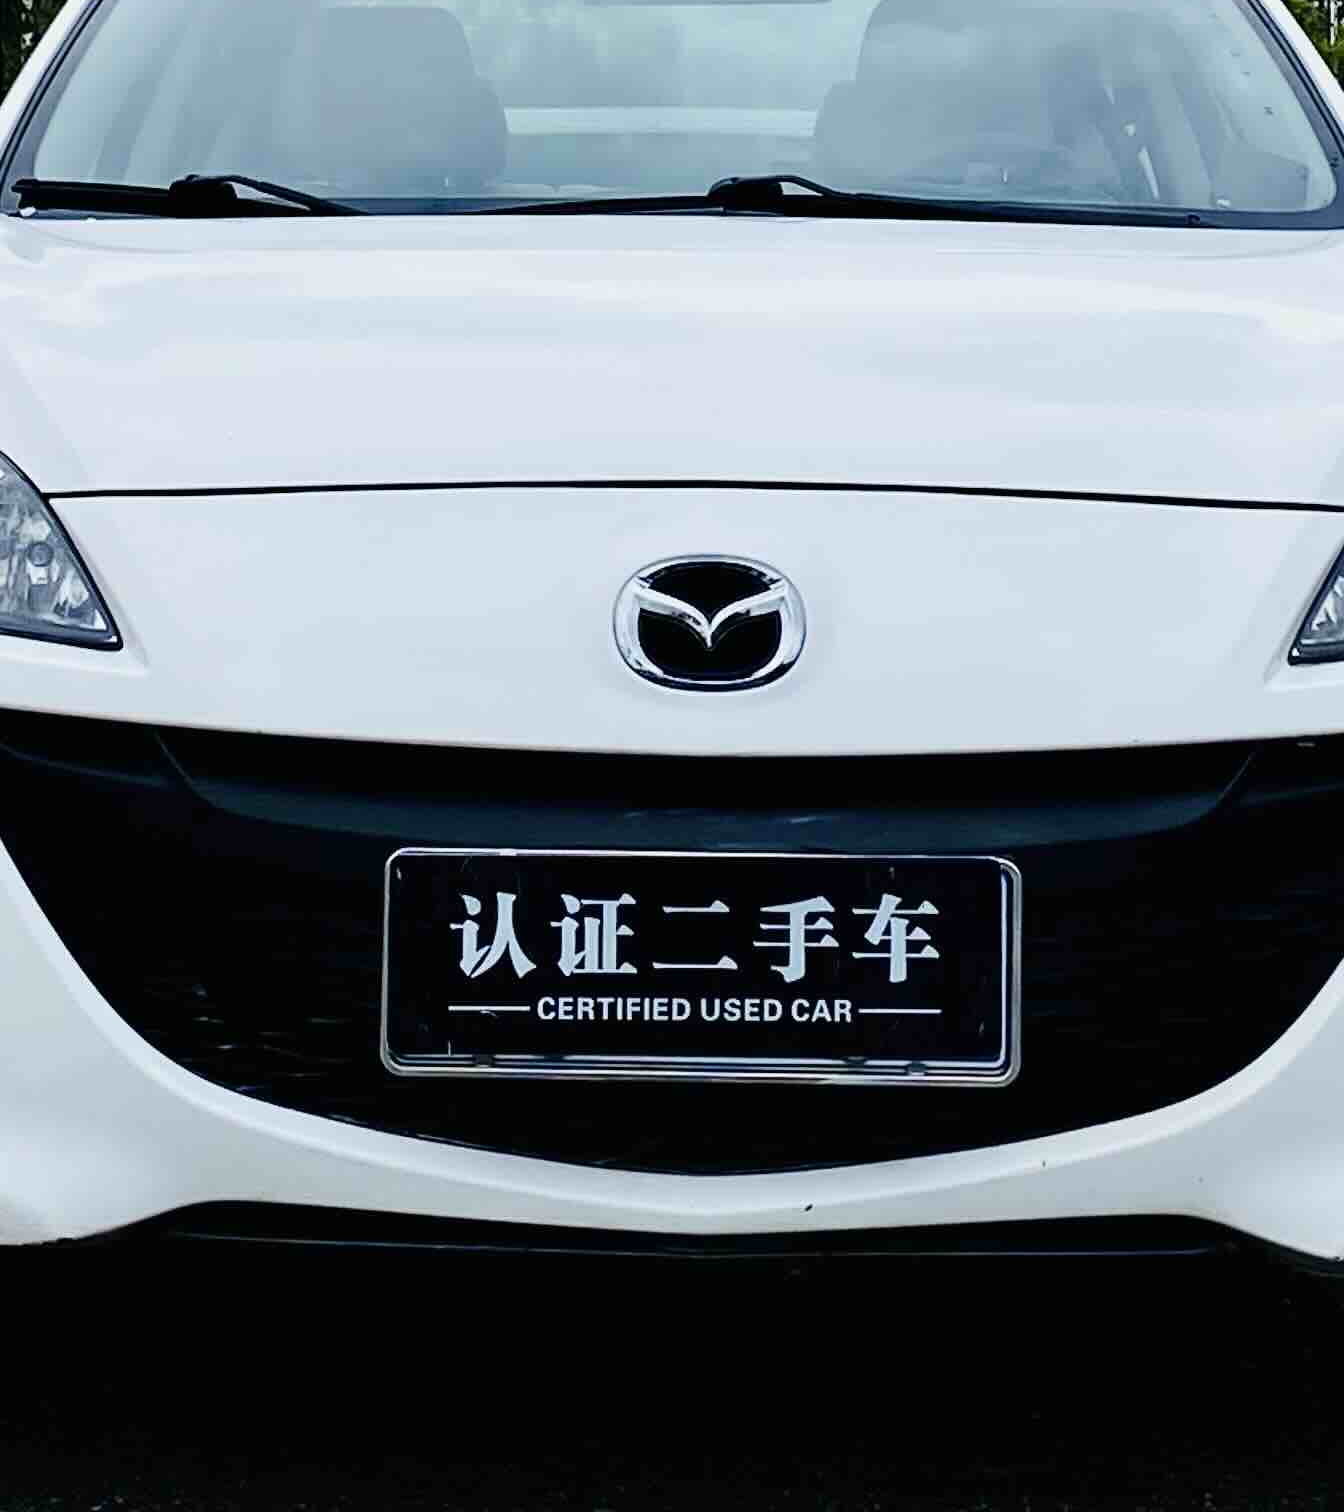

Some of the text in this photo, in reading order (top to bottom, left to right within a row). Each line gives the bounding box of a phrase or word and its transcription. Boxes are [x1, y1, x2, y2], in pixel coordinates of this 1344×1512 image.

[449, 891, 940, 983] 认证二手车
[536, 996, 853, 1023] CERTIFIED USED CAR
